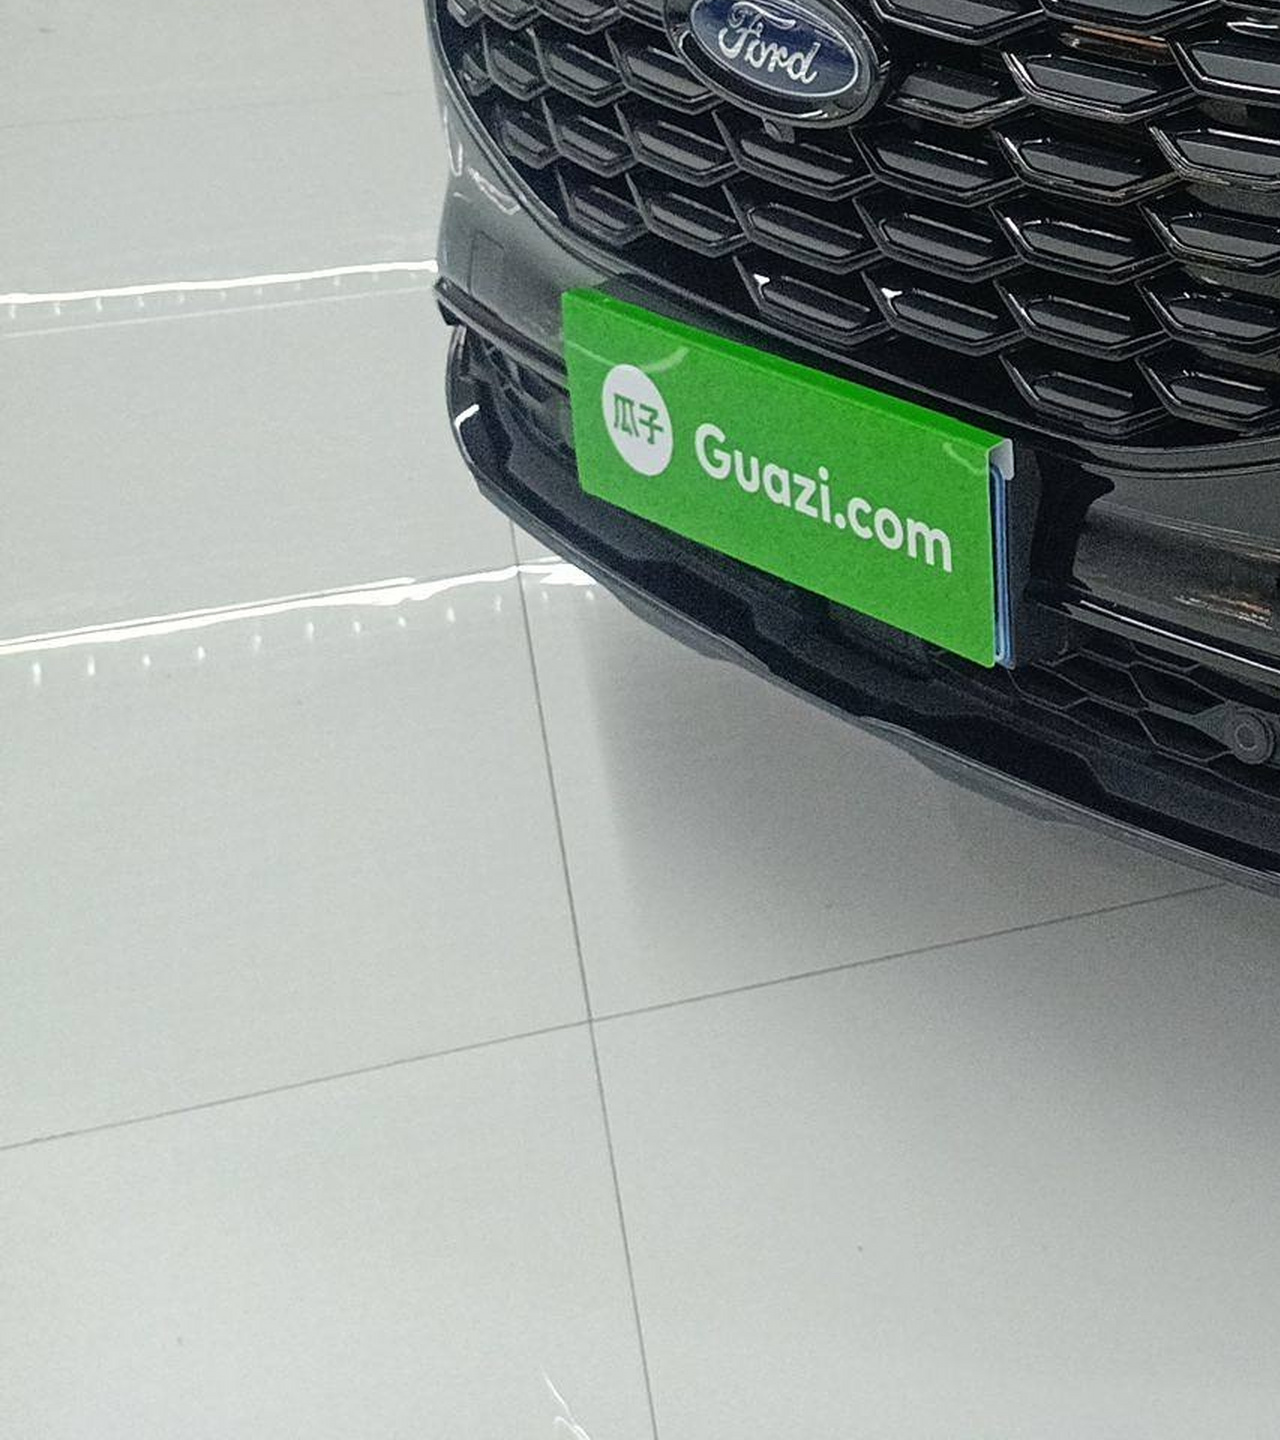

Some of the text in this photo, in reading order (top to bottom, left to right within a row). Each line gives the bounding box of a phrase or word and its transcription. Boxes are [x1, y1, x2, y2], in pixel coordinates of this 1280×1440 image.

[718, 1, 821, 84] Ford
[612, 391, 665, 446] 瓜子
[693, 422, 953, 573] Guazi.com
